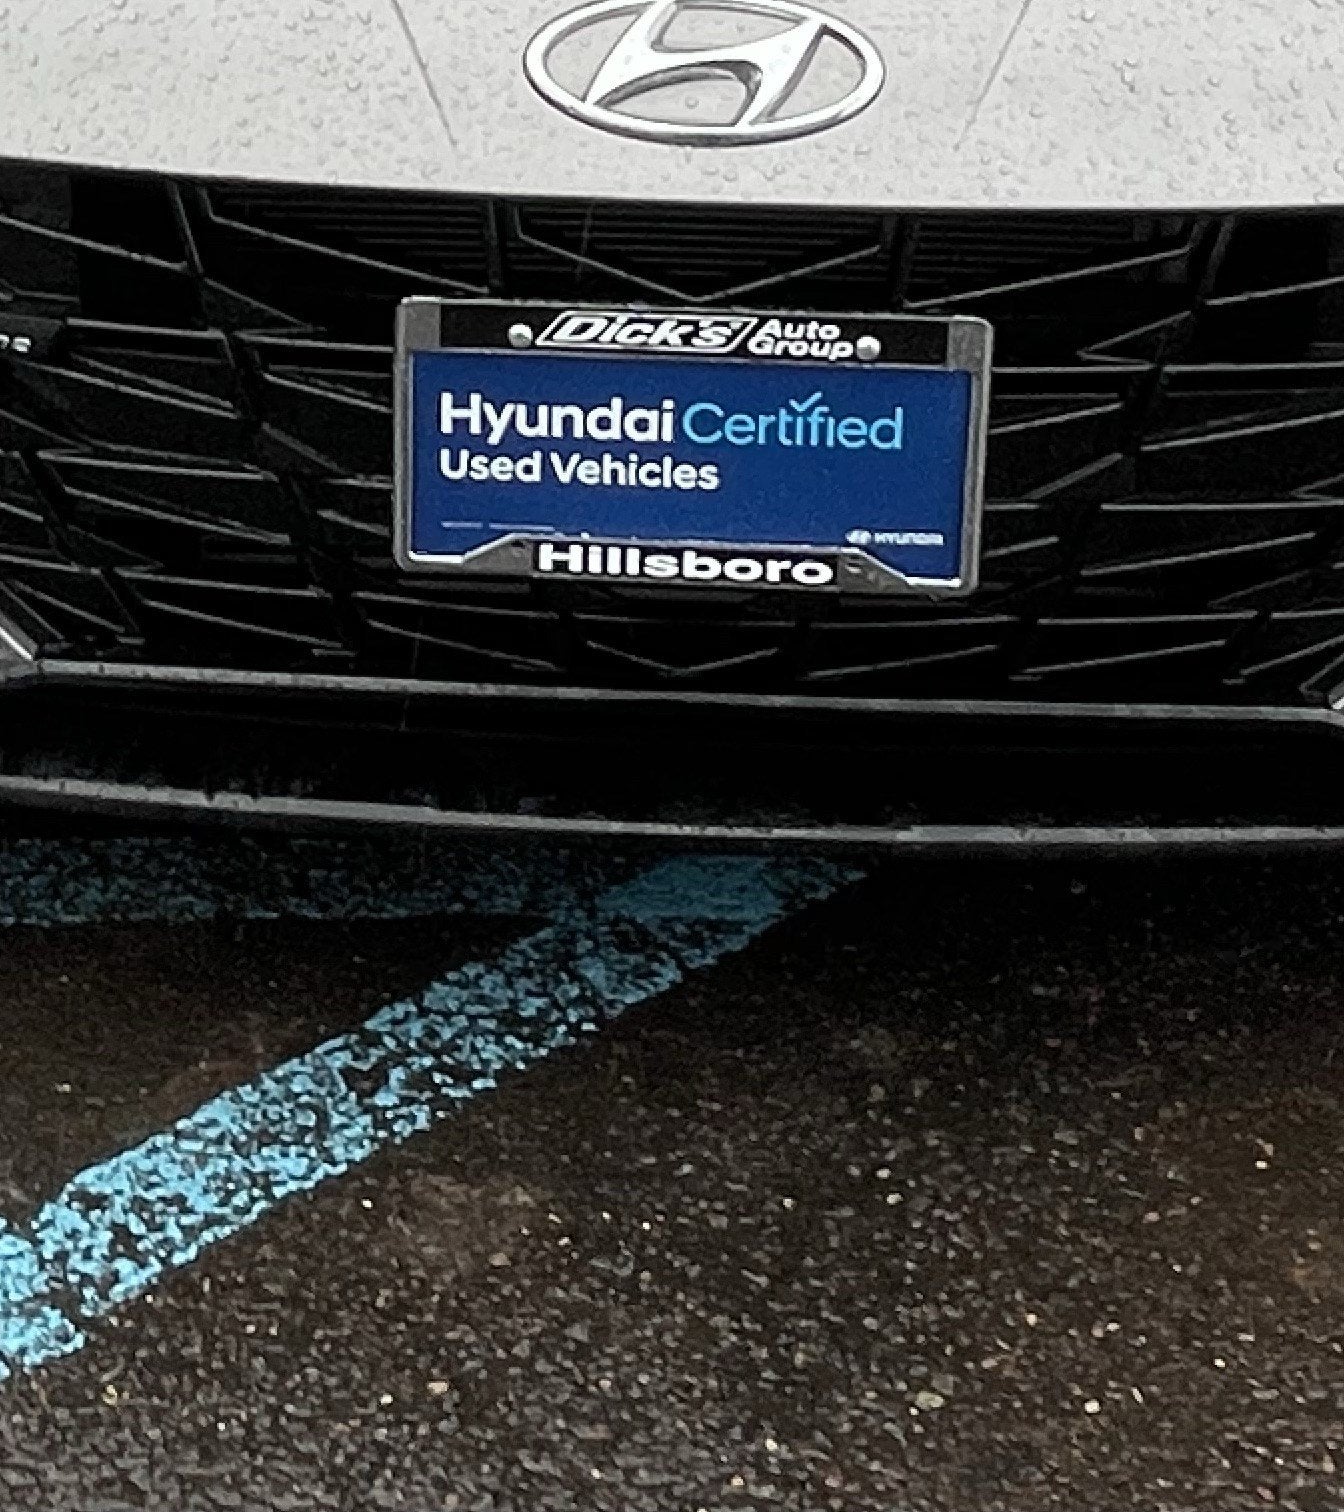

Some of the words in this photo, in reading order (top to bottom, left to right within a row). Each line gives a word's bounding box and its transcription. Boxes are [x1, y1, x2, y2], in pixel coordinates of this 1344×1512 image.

[747, 336, 854, 361] Group
[757, 318, 840, 339] Auto
[440, 392, 675, 445] Hyundai
[682, 392, 904, 450] Certified
[440, 448, 542, 483] Used
[550, 452, 720, 491] Vehicles
[538, 543, 834, 586] Hillsboro
